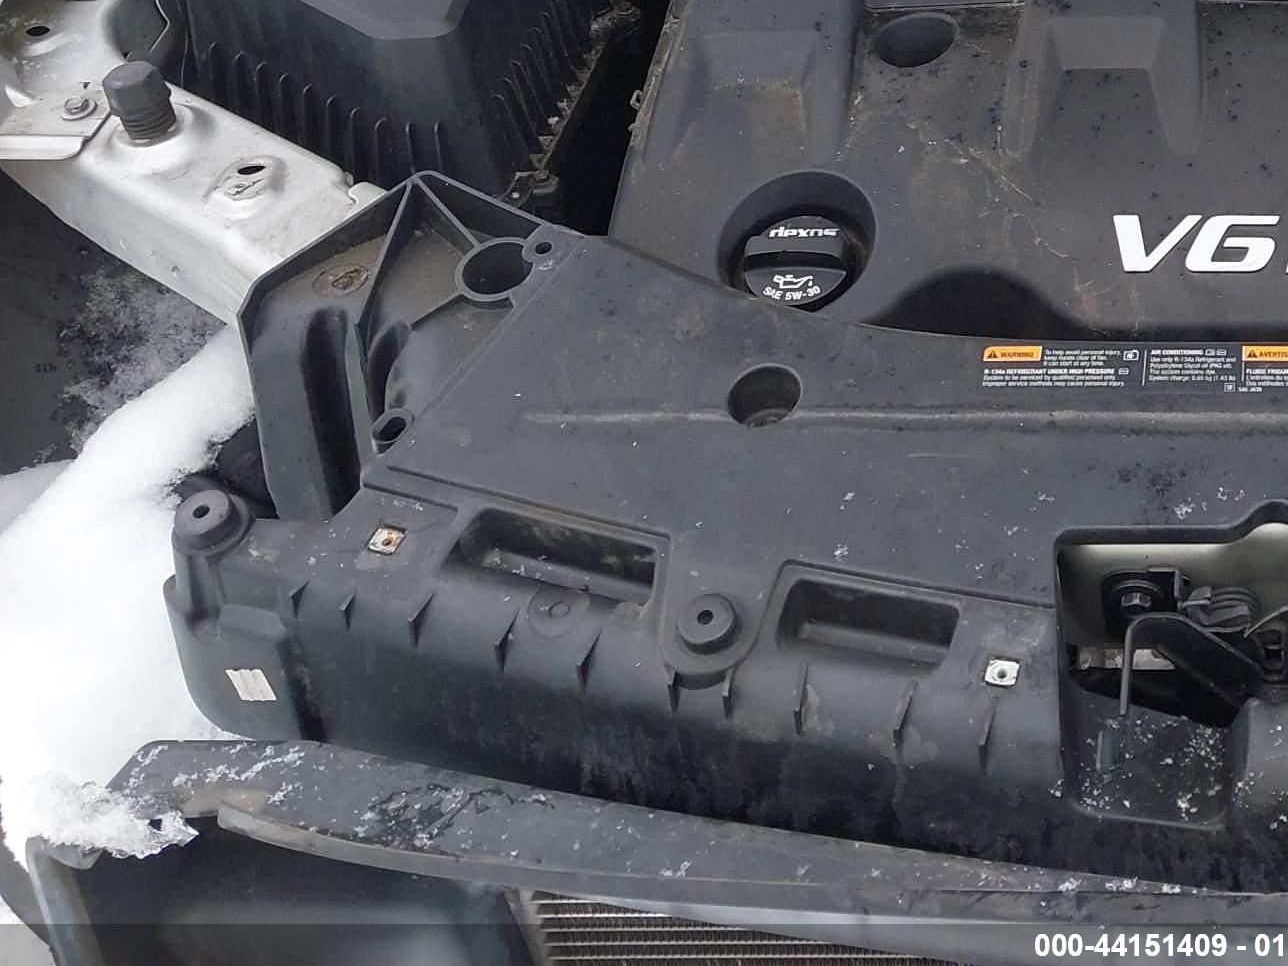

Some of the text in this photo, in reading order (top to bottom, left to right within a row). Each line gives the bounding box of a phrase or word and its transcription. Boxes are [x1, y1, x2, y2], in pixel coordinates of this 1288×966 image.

[1113, 215, 1281, 273] V6
[763, 286, 821, 301] SAE 5W-30
